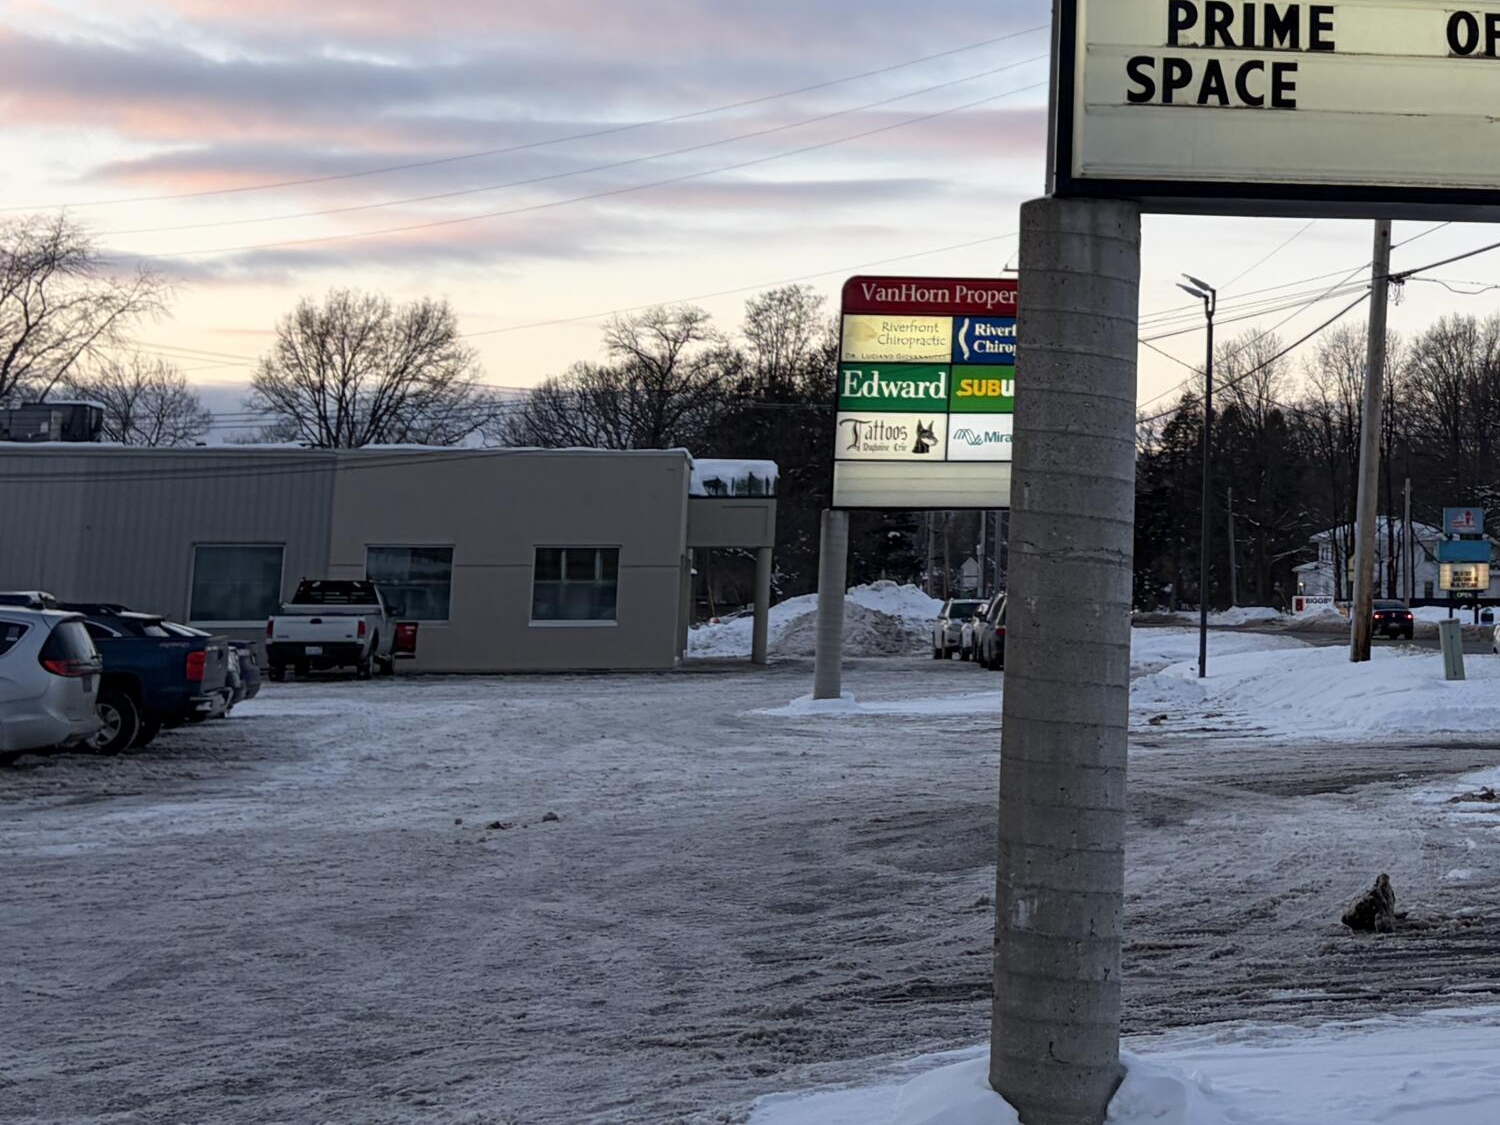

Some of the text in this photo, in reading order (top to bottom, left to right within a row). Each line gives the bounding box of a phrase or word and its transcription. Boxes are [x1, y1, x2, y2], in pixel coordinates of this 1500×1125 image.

[1126, 55, 1298, 109] SPACE
[861, 283, 950, 303] VanHorn
[882, 320, 939, 333] Riverfront
[878, 334, 946, 348] Chiropractic
[841, 371, 948, 398] Edward
[839, 418, 908, 452] Tattoos
